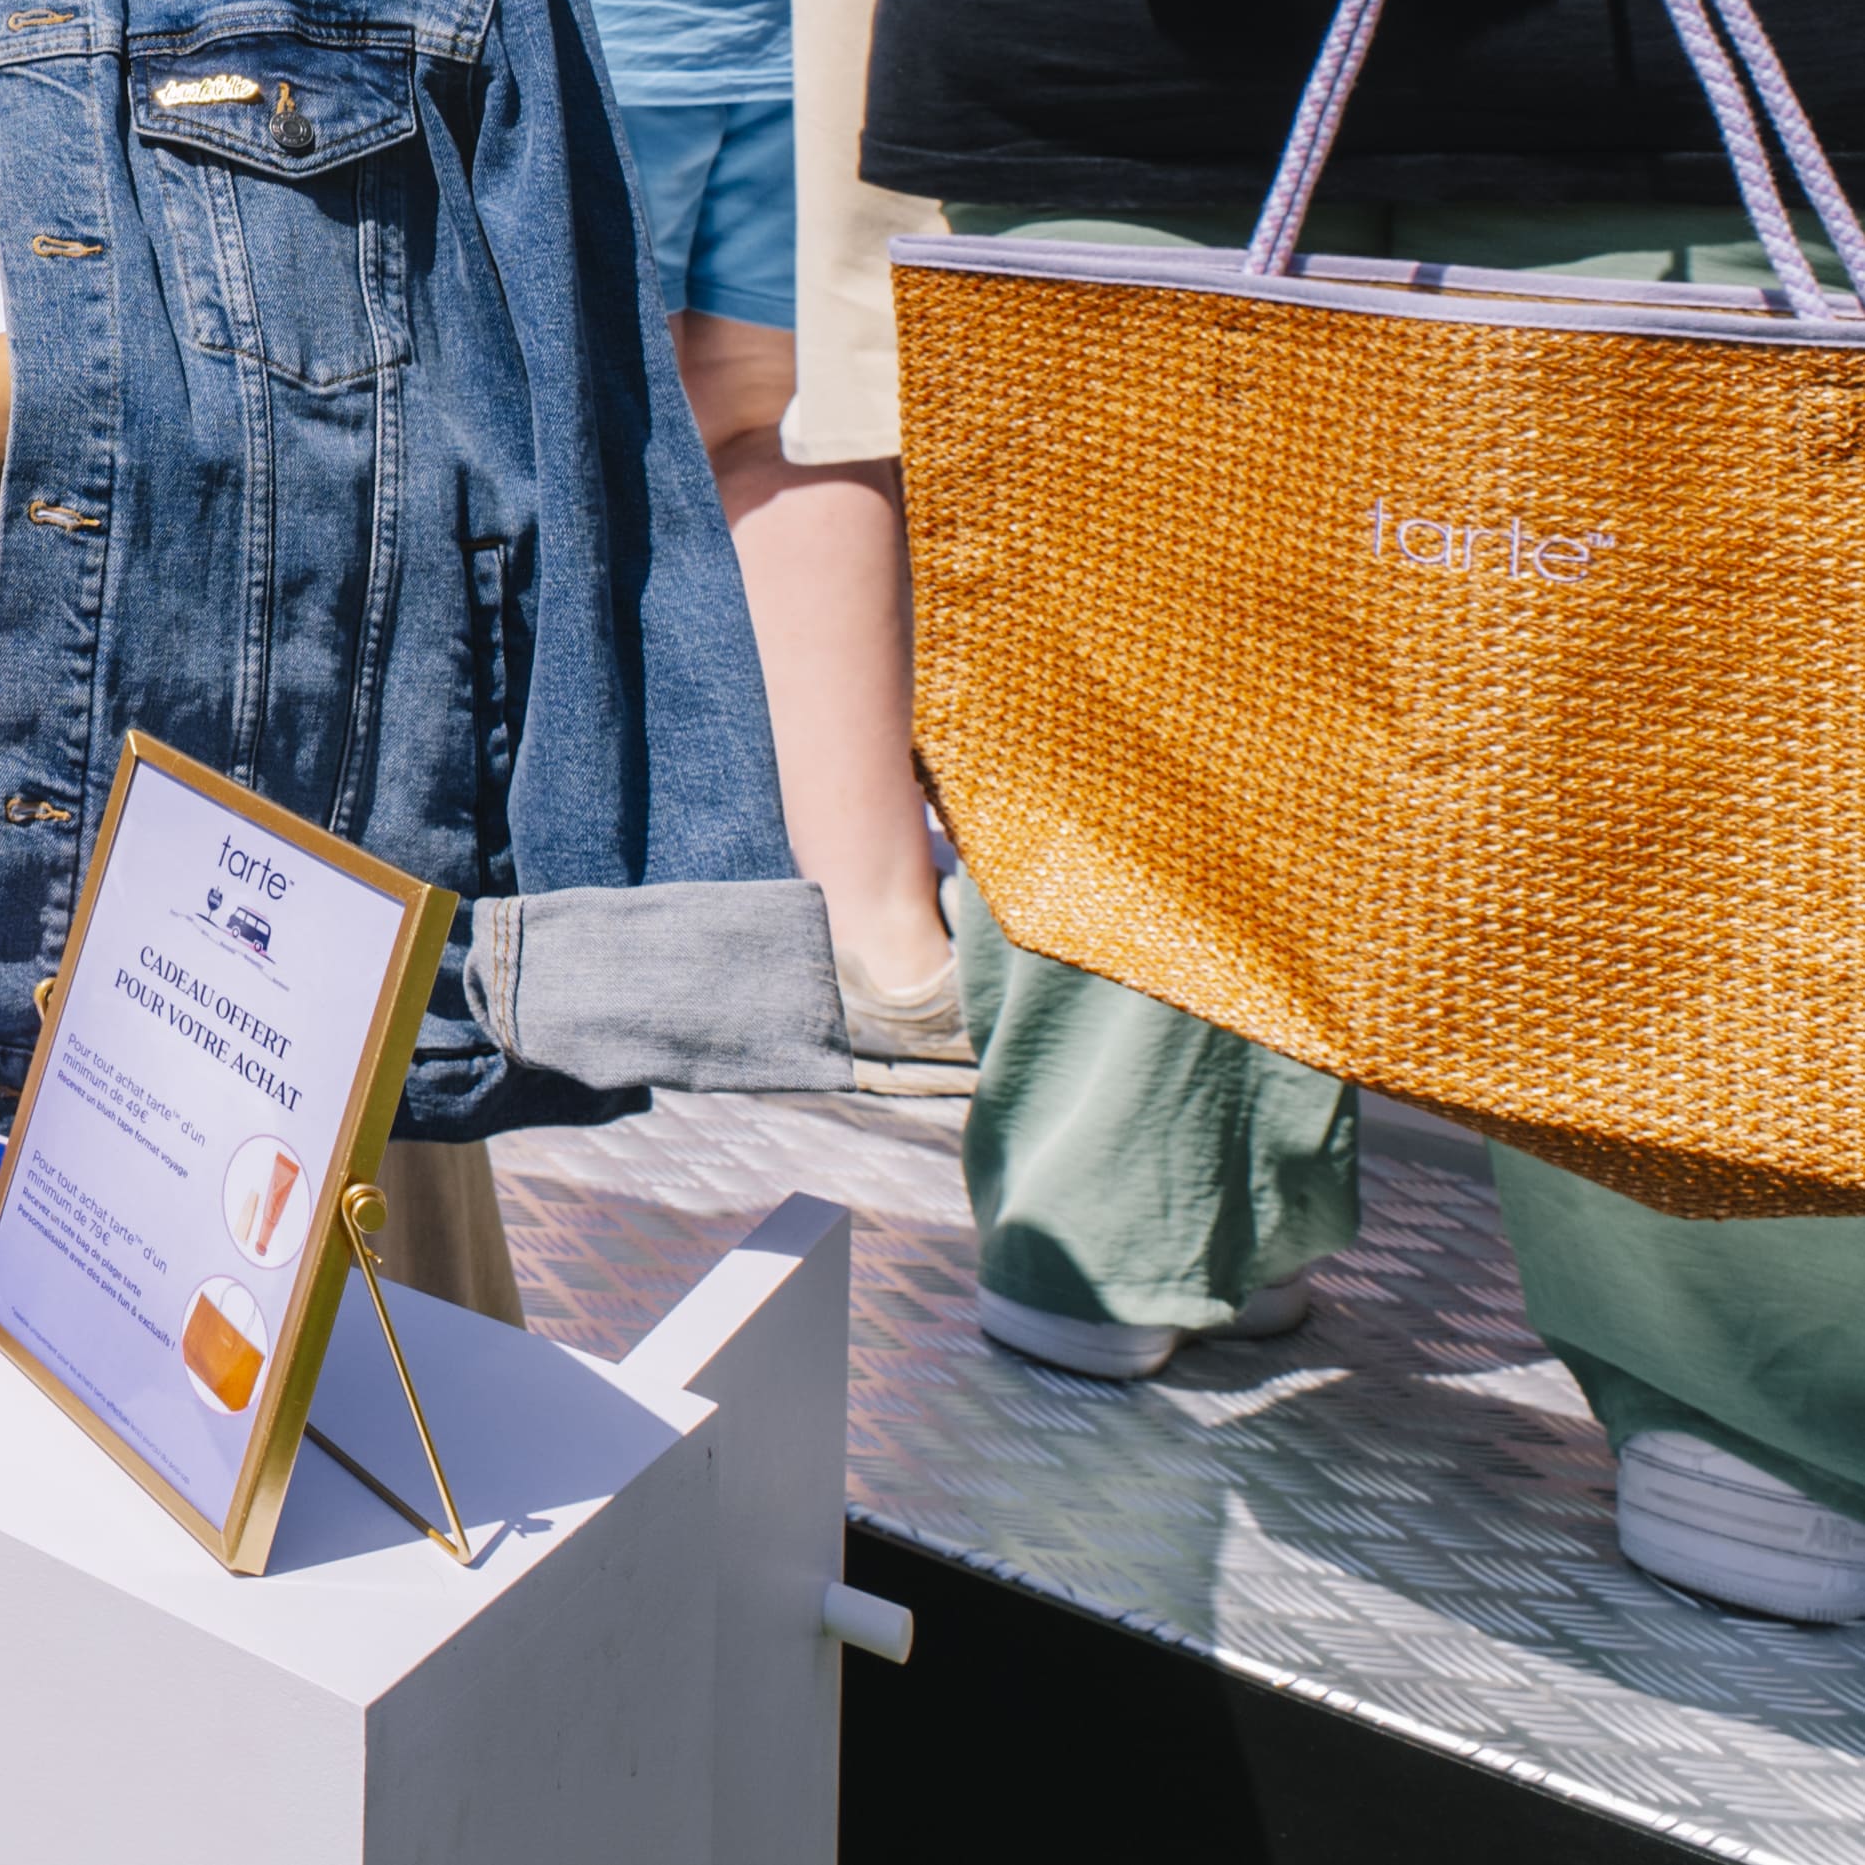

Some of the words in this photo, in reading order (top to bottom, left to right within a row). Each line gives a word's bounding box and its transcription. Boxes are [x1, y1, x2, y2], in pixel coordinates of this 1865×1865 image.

[114, 968, 165, 1019] POUR
[168, 1002, 231, 1064] VOTRE
[230, 1051, 303, 1113] ACHAT
[139, 945, 216, 1008] CADEAU
[215, 996, 293, 1060] OFFERT
[57, 1069, 86, 1099] Recevez
[86, 1094, 96, 1106] un
[96, 1100, 117, 1123] blush
[116, 1115, 134, 1136] tape
[134, 1130, 161, 1157] format
[160, 1151, 189, 1179] voyage
[62, 1052, 109, 1095] minimum
[109, 1087, 124, 1105] de
[125, 1099, 150, 1124] 49€
[67, 1033, 92, 1059] Pour
[92, 1052, 115, 1077] tout
[115, 1072, 145, 1101] achat
[181, 1120, 206, 1148] d'un
[22, 1186, 51, 1217] Recevez
[50, 1212, 61, 1227] un
[60, 1219, 76, 1240] tote
[75, 1232, 91, 1253] bag
[90, 1248, 101, 1262] de
[100, 1257, 123, 1282] plage
[123, 1273, 142, 1298] tarte
[27, 1168, 73, 1215] minimum
[73, 1208, 88, 1227] de
[89, 1220, 111, 1247] 79€
[32, 1149, 56, 1178] Pour
[57, 1171, 79, 1199] tout
[78, 1192, 109, 1224] achat
[143, 1246, 168, 1276] d'un
[69, 1251, 87, 1272] avec
[86, 1267, 101, 1285] des
[100, 1279, 117, 1299] pins
[116, 1292, 131, 1311] fun
[130, 1305, 138, 1317] &
[137, 1312, 171, 1348] exclusifs
